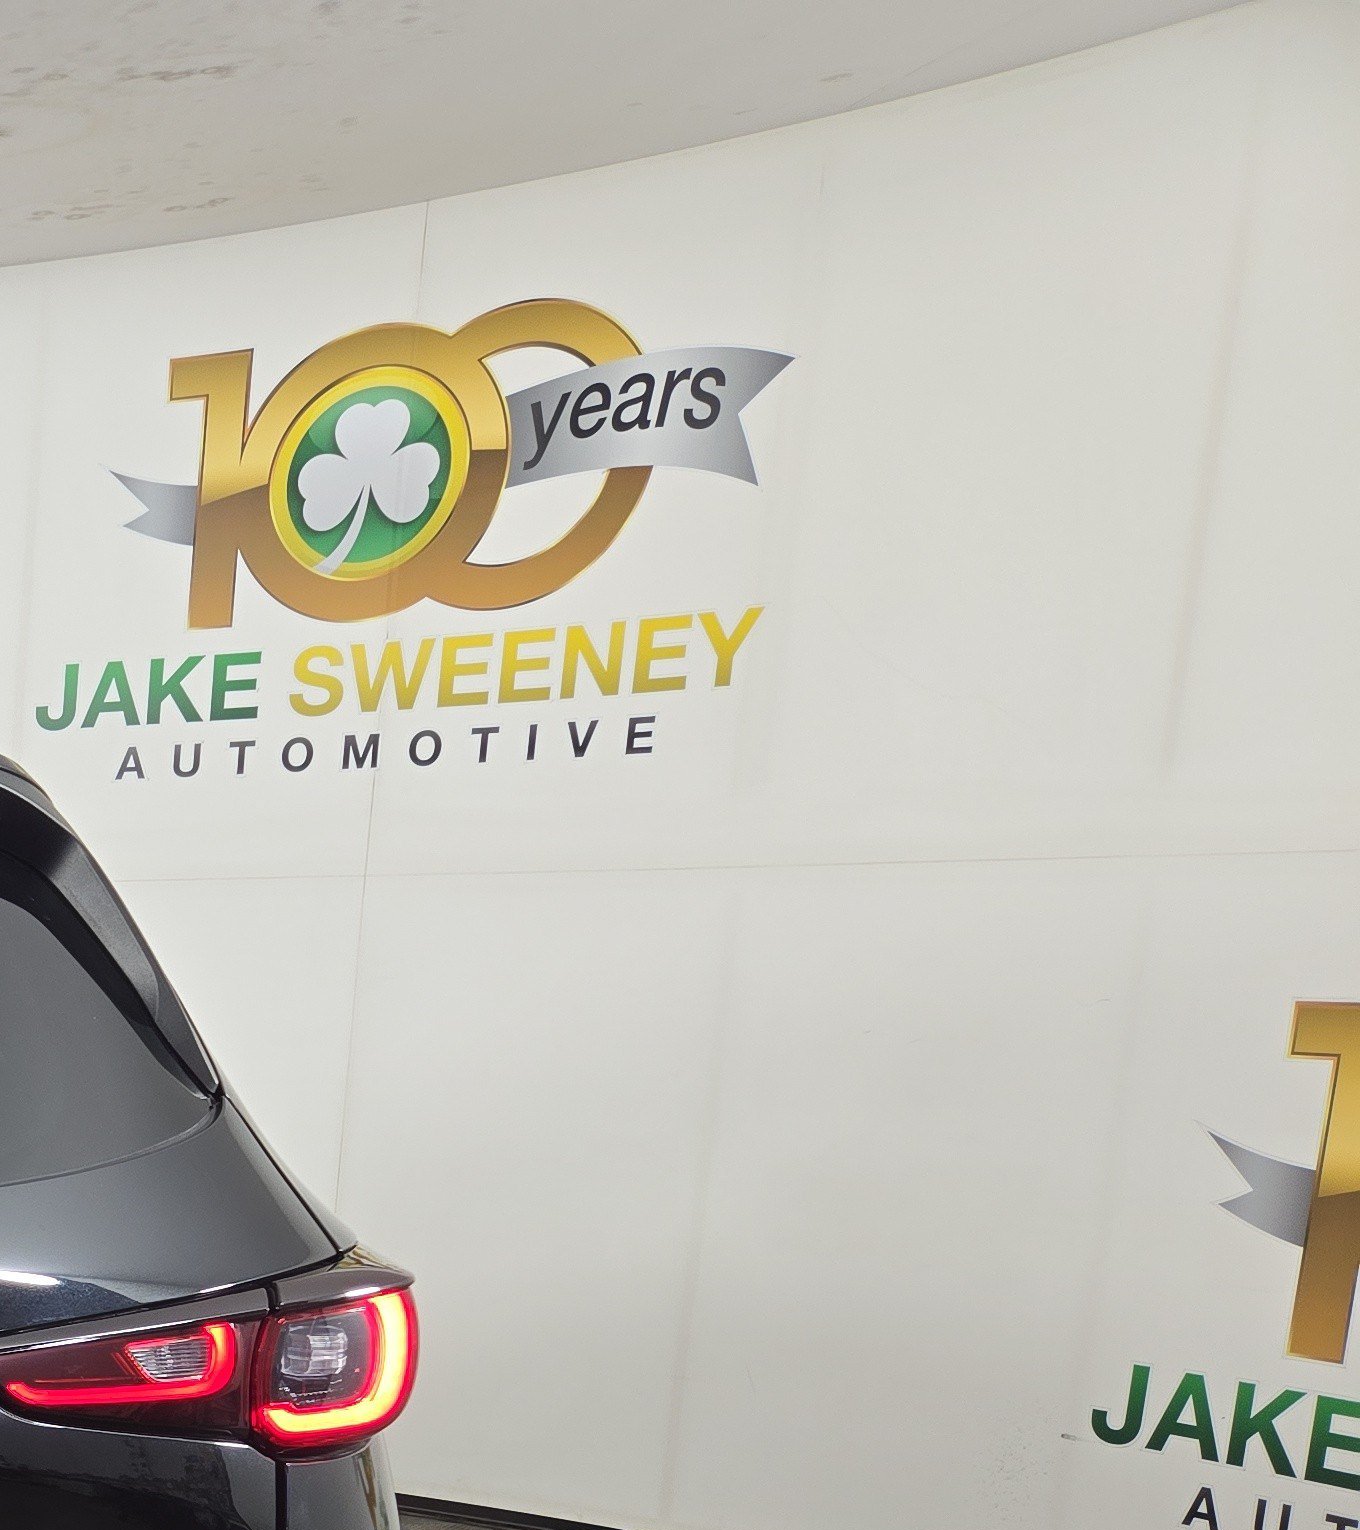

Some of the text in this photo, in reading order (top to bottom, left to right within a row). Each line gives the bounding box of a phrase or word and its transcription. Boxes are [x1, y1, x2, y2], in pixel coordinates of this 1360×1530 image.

[523, 367, 727, 471] years
[35, 606, 765, 731] JAKE SWEENEY
[115, 716, 657, 781] AUTOMOTIVE
[1091, 1364, 1360, 1491] JAKE
